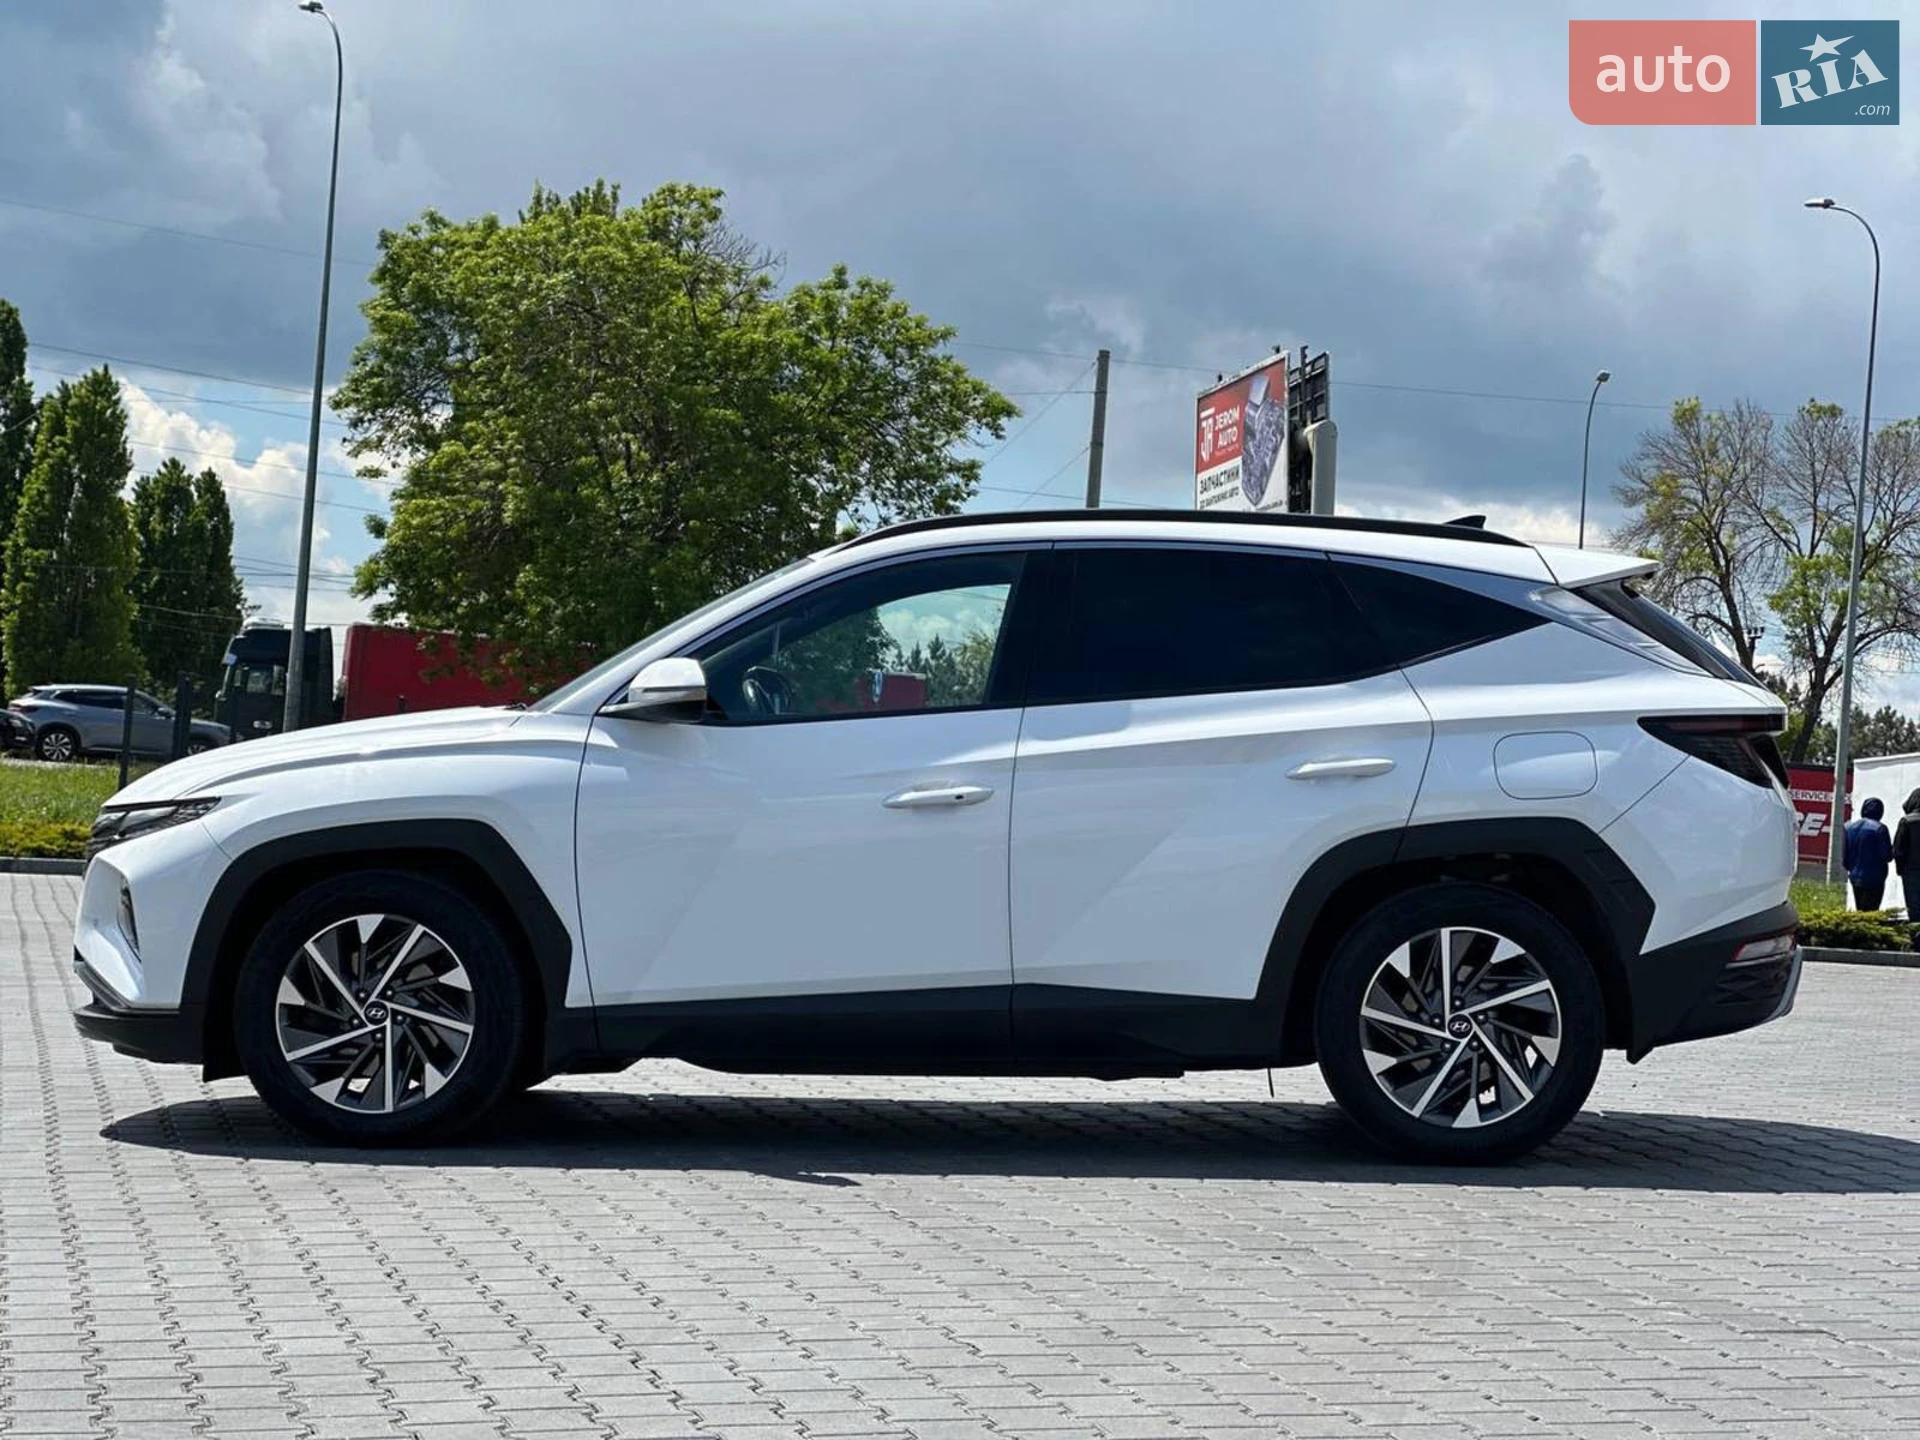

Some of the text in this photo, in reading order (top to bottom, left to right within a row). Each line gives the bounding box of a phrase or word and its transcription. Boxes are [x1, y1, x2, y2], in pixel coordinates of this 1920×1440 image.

[1215, 405, 1240, 431] JEROM
[1218, 426, 1238, 450] AUTO
[1200, 465, 1240, 495] ЗАПЧАСТИНИ
